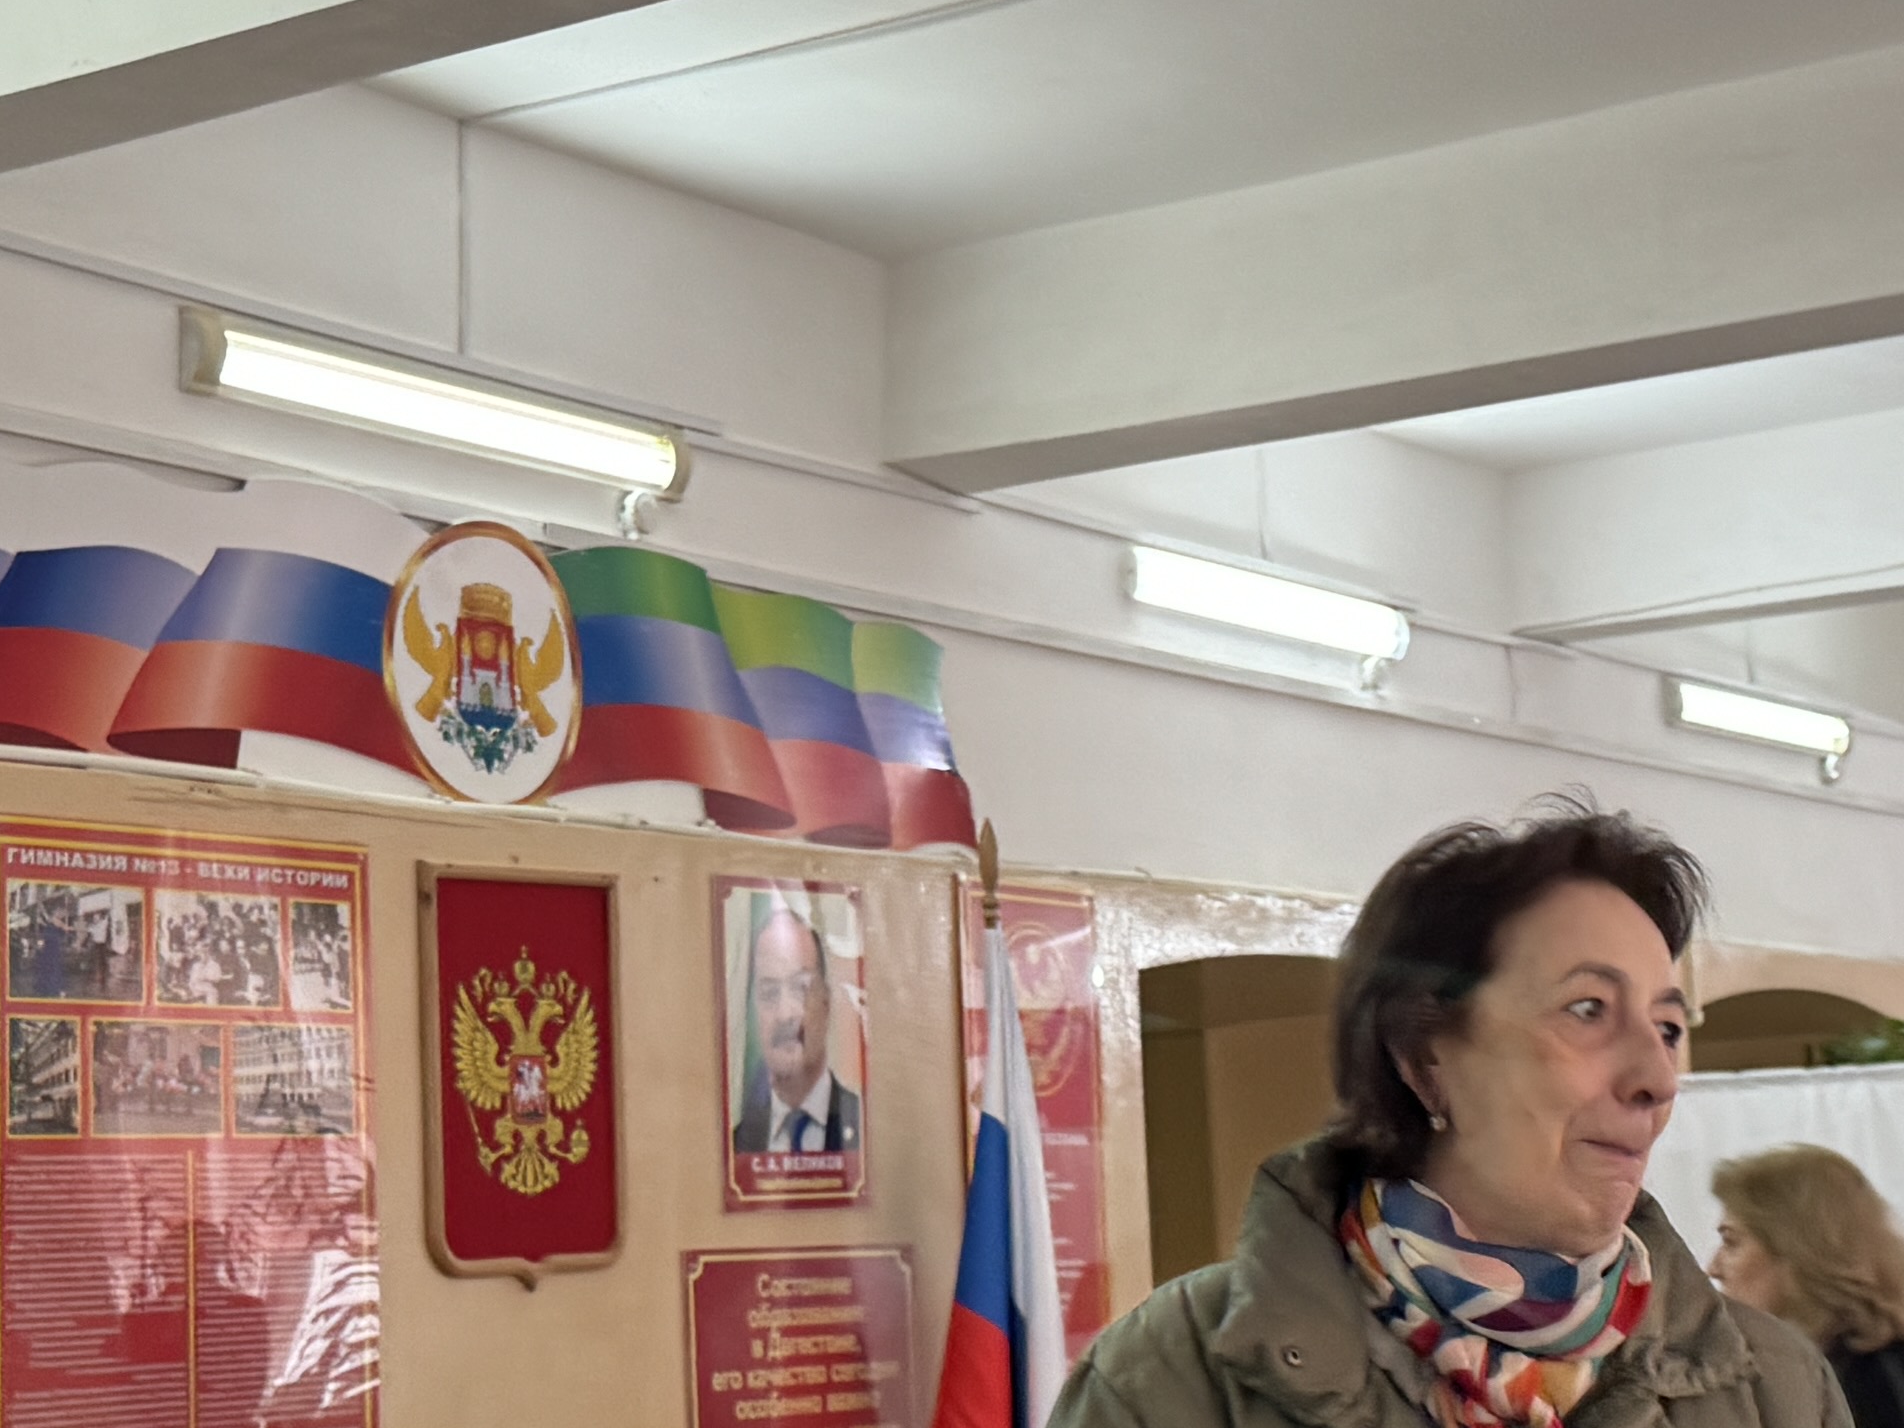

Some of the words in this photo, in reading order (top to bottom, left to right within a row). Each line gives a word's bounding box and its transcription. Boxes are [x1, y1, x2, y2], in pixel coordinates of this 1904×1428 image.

[7, 847, 127, 872] ГИМНАЗИЯ
[197, 861, 250, 881] ВЕХИ
[256, 867, 348, 889] ИСТОРИИ
